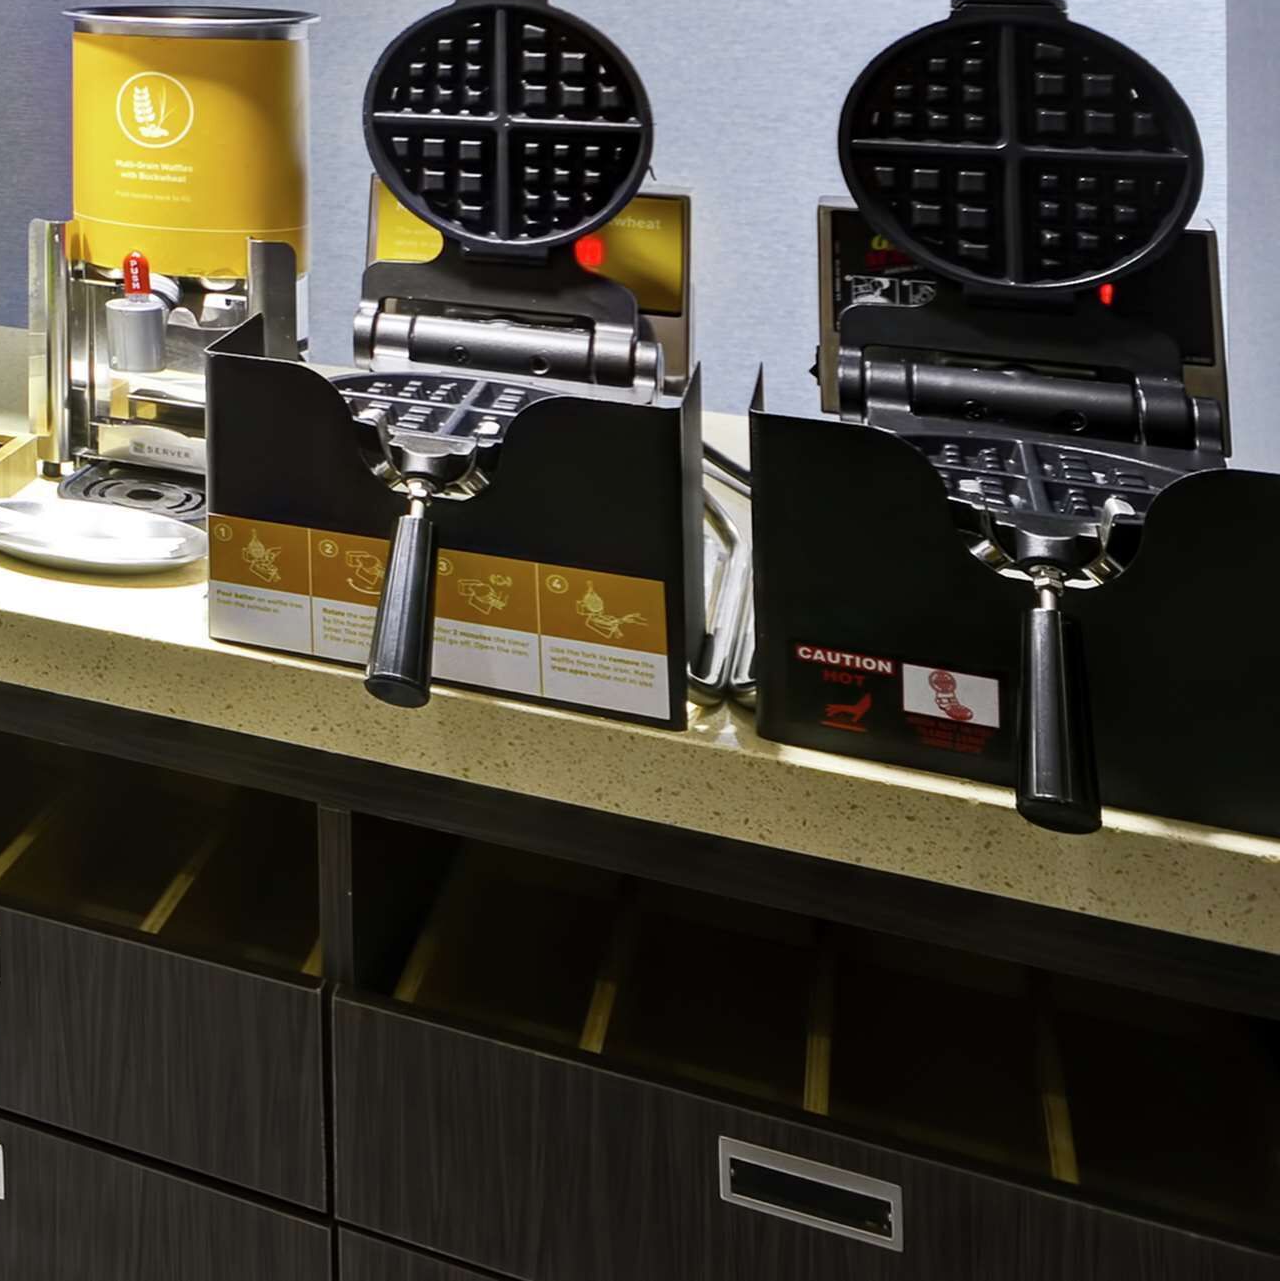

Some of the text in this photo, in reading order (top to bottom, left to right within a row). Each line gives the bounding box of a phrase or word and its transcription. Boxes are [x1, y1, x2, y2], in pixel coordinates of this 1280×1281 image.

[129, 259, 141, 290] PUSH
[147, 444, 191, 459] SERVER
[797, 646, 893, 674] CAUTION
[823, 671, 866, 687] HOT
